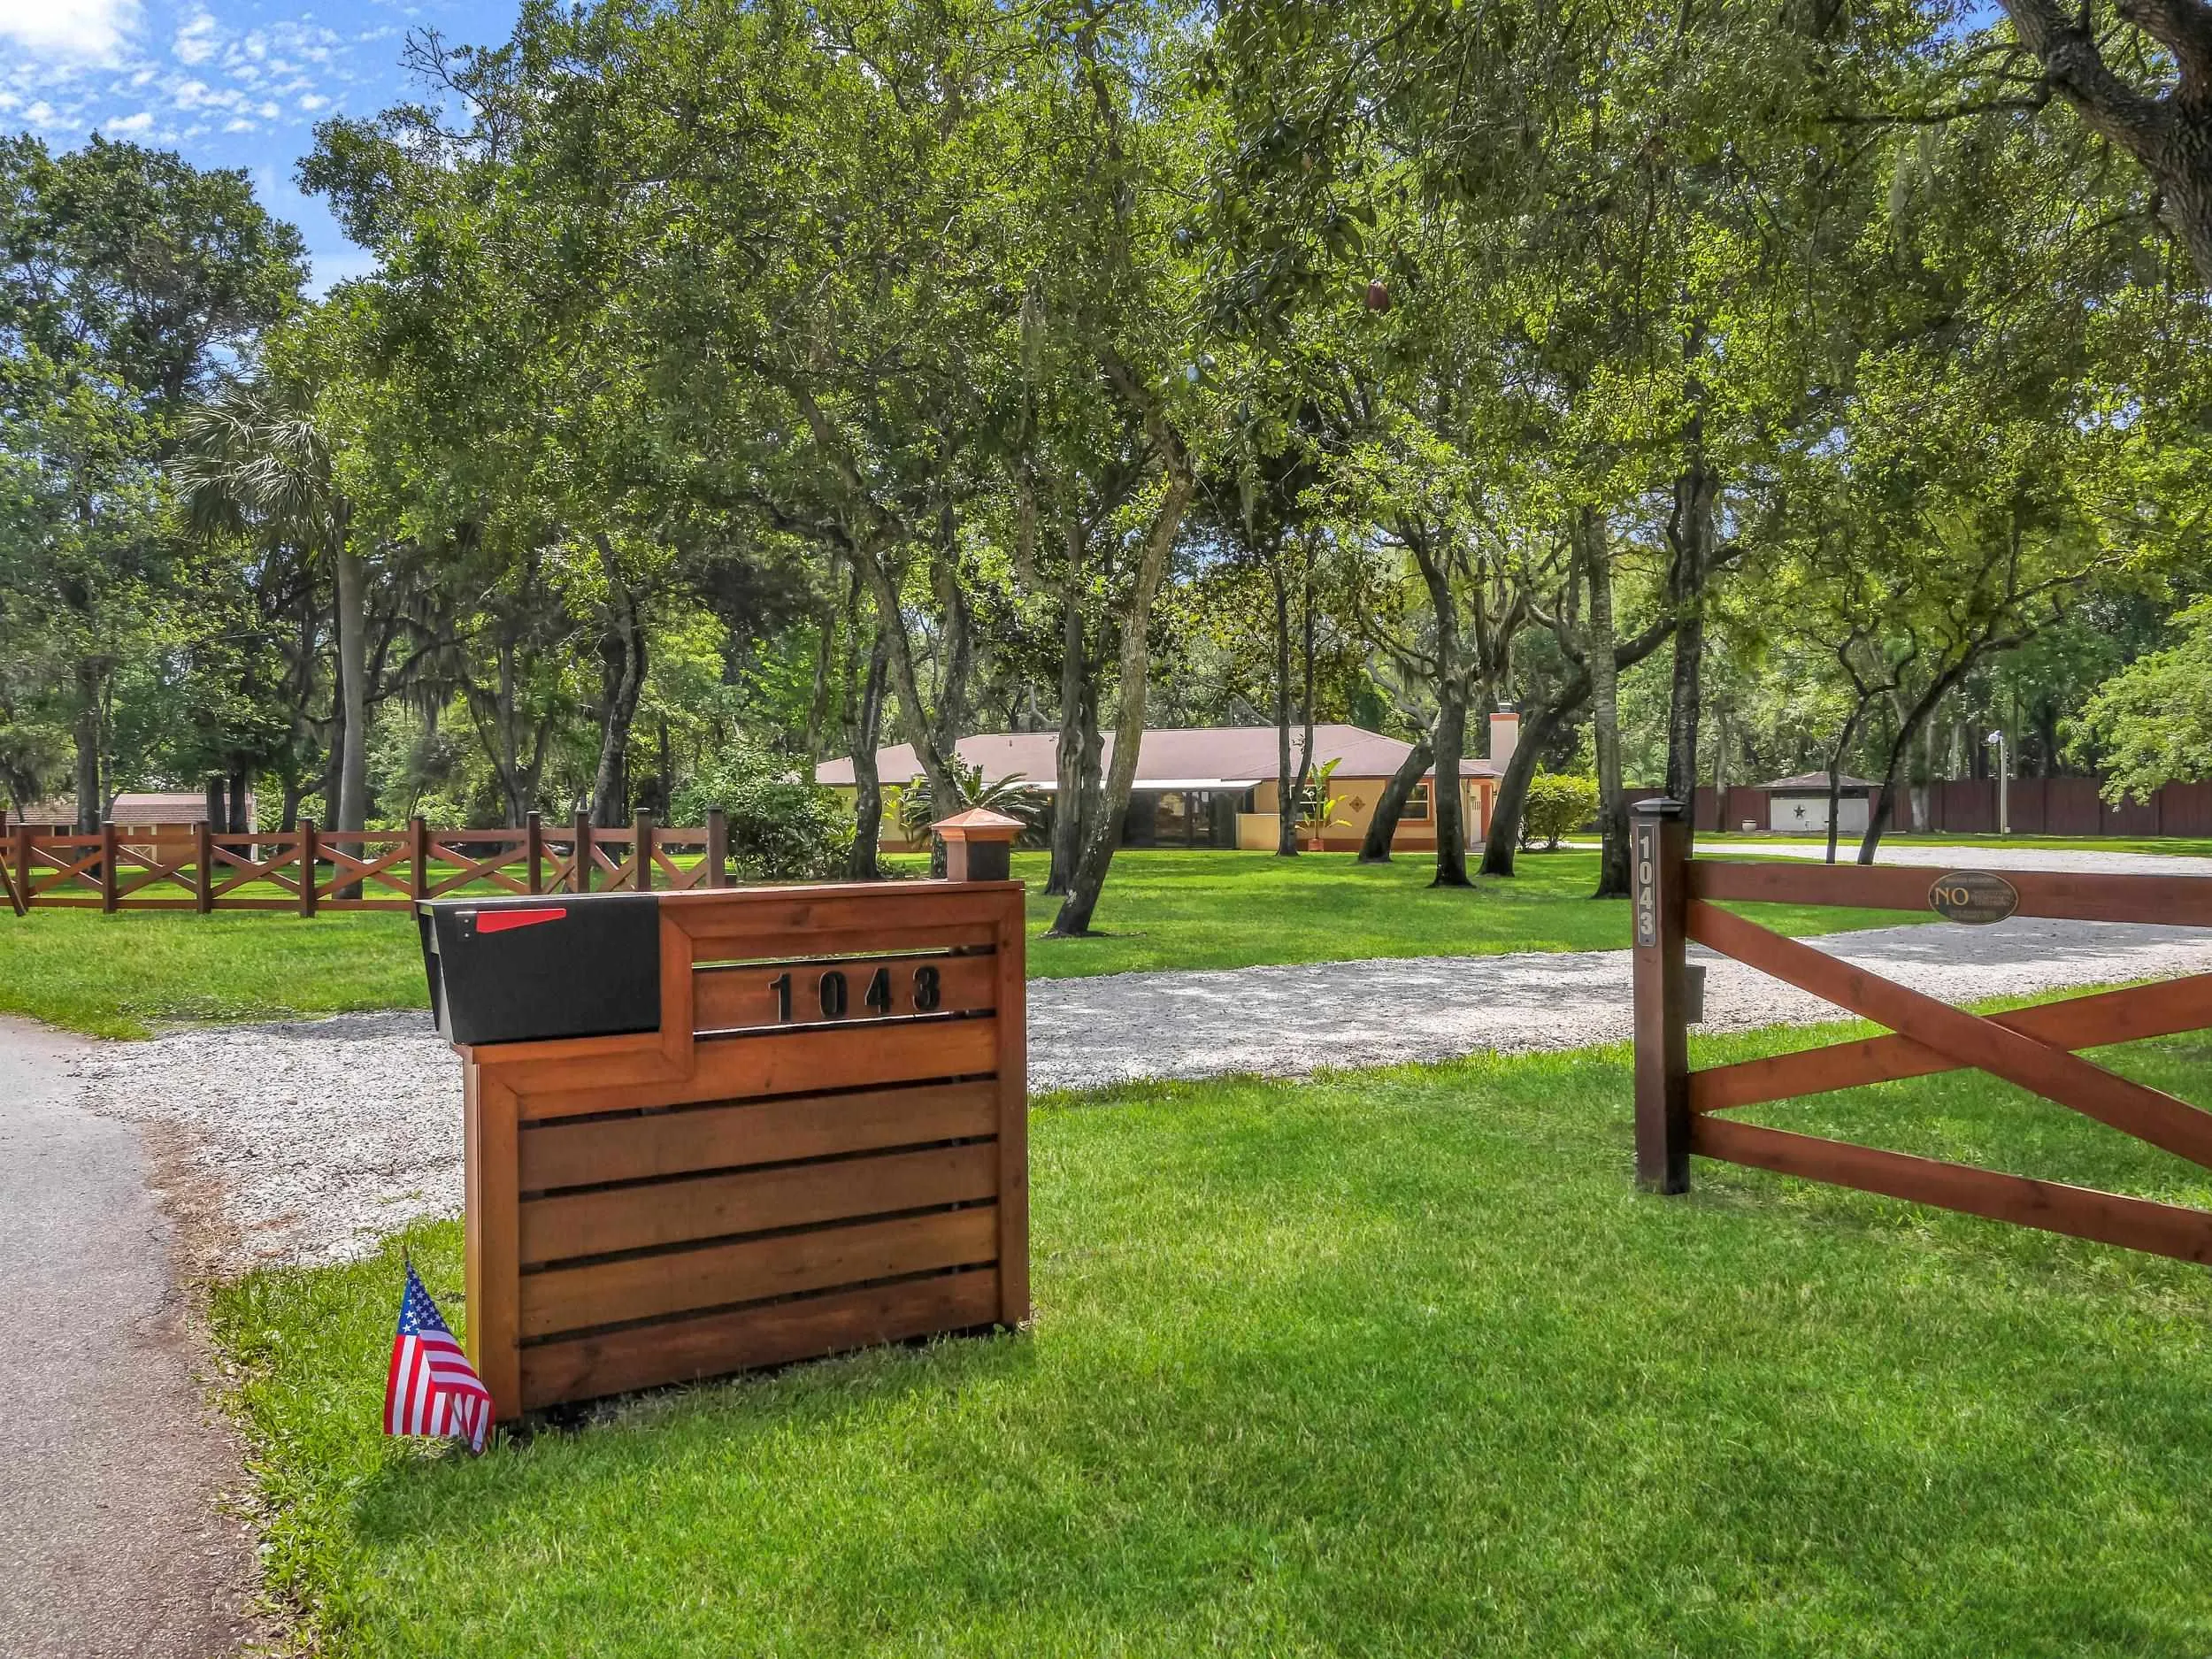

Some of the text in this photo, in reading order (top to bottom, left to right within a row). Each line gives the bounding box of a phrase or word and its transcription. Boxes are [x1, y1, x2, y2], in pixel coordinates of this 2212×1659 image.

[1640, 835, 1653, 934] 1043
[1935, 887, 1969, 905] NO
[768, 966, 941, 1025] 1043
